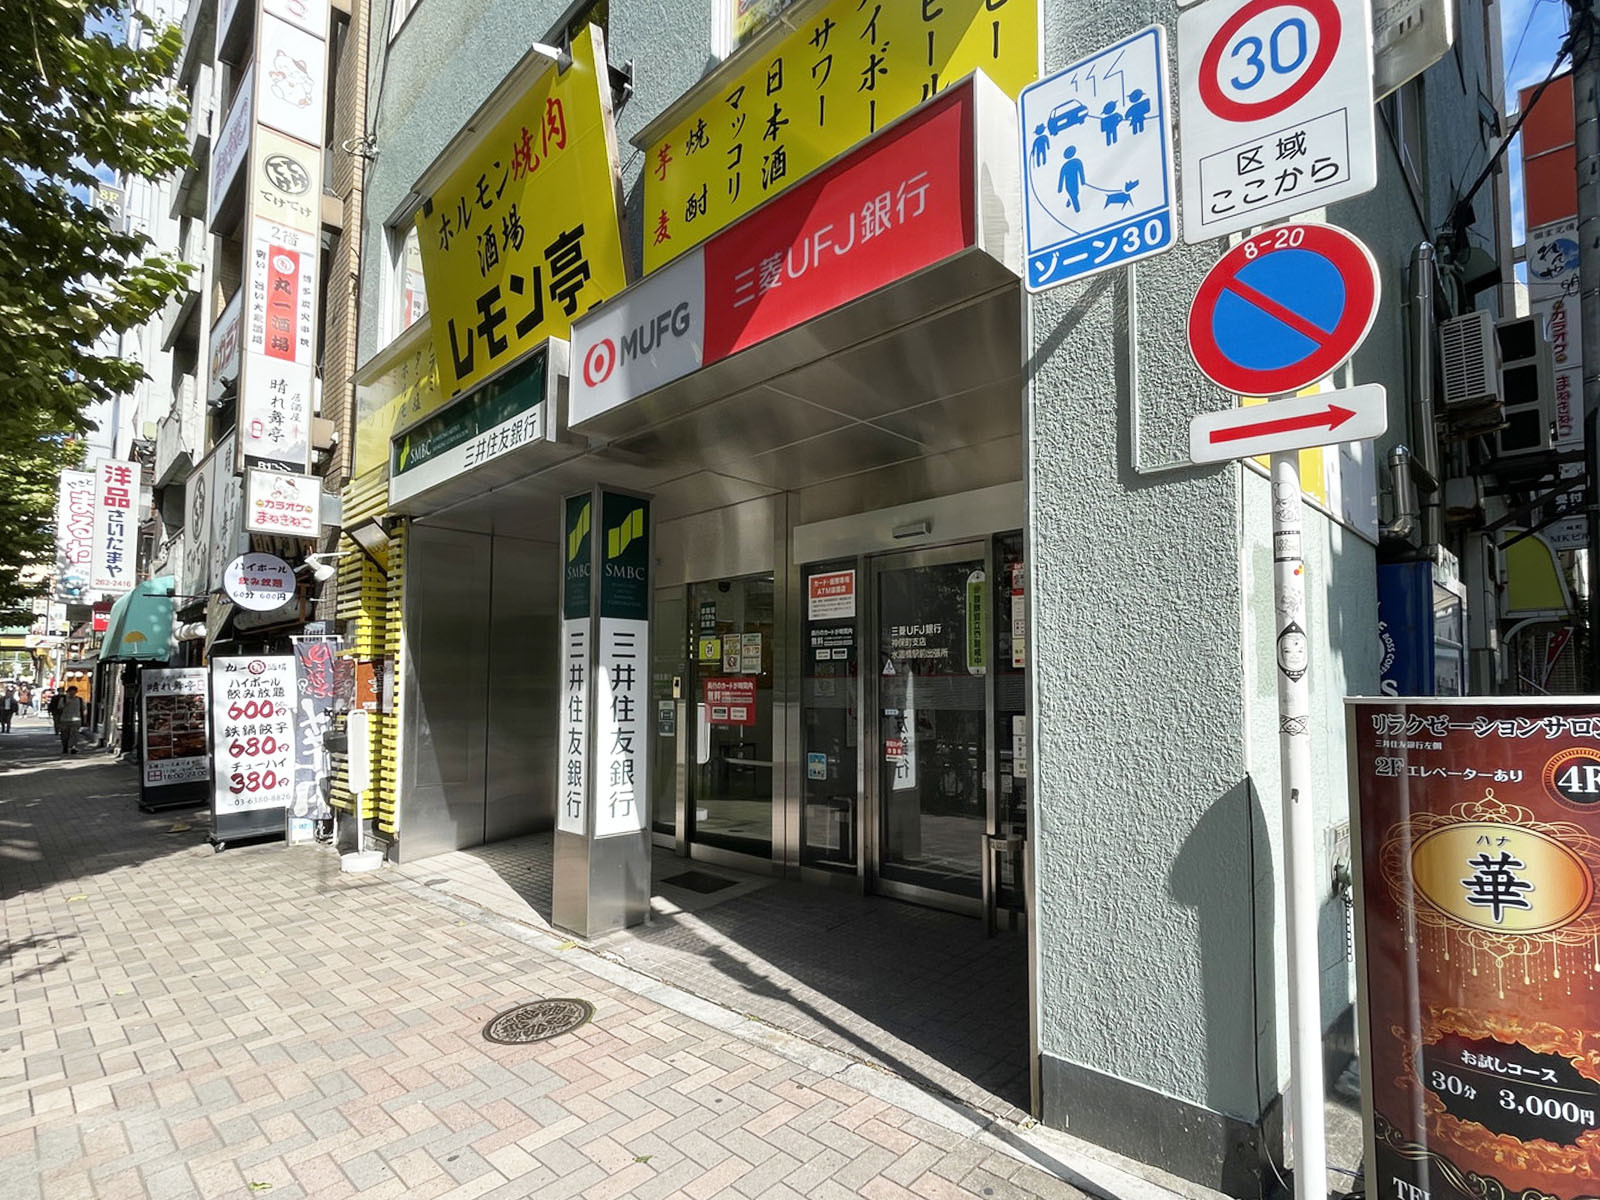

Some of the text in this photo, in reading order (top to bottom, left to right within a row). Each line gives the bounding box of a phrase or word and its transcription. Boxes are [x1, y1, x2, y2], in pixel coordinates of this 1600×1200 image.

[808, 18, 837, 127] サワー
[1230, 17, 1308, 91] 30
[725, 85, 747, 205] マッコリ
[761, 57, 790, 191] 日本酒
[438, 97, 566, 252] ホルモン焼肉
[1237, 130, 1308, 176] 区域
[260, 190, 311, 218] てけてけ
[653, 143, 673, 246] 芋 麦
[1211, 157, 1340, 215] ここから
[477, 203, 526, 278] 酒場
[734, 171, 931, 308] 三菱UFJ銀行
[1034, 218, 1163, 284] ゾーン30
[1243, 228, 1305, 260] 8-20
[447, 222, 593, 382] レモン亭
[620, 301, 690, 367] MUFG
[1552, 310, 1569, 355] カラオケ
[290, 393, 302, 422] 居酒屋
[464, 412, 537, 468] 三井住友銀行
[104, 465, 132, 578] 洋品 さいたまや
[255, 511, 312, 529] まねきねこ
[264, 499, 306, 512] カラオケ
[235, 563, 288, 574] ハイボール
[567, 562, 592, 580] SMBC
[605, 562, 645, 581] SMBC
[891, 623, 942, 637] 三菱UFJ銀行
[227, 687, 286, 699] 飲み放題
[229, 677, 281, 688] ハイボール
[225, 722, 288, 737] 鉄鍋餃子
[566, 632, 585, 819] 三井住友銀行
[609, 632, 636, 819] 三井住友銀行
[1374, 739, 1443, 750] 三井住友銀行左側
[232, 758, 287, 772] チューハイ
[1375, 756, 1523, 783] 2F エレベーターあり
[1476, 835, 1511, 847] ハナ
[1461, 850, 1534, 922] 華
[1461, 1049, 1558, 1083] お試しコース
[1431, 1070, 1595, 1126] 30分 3,000円
